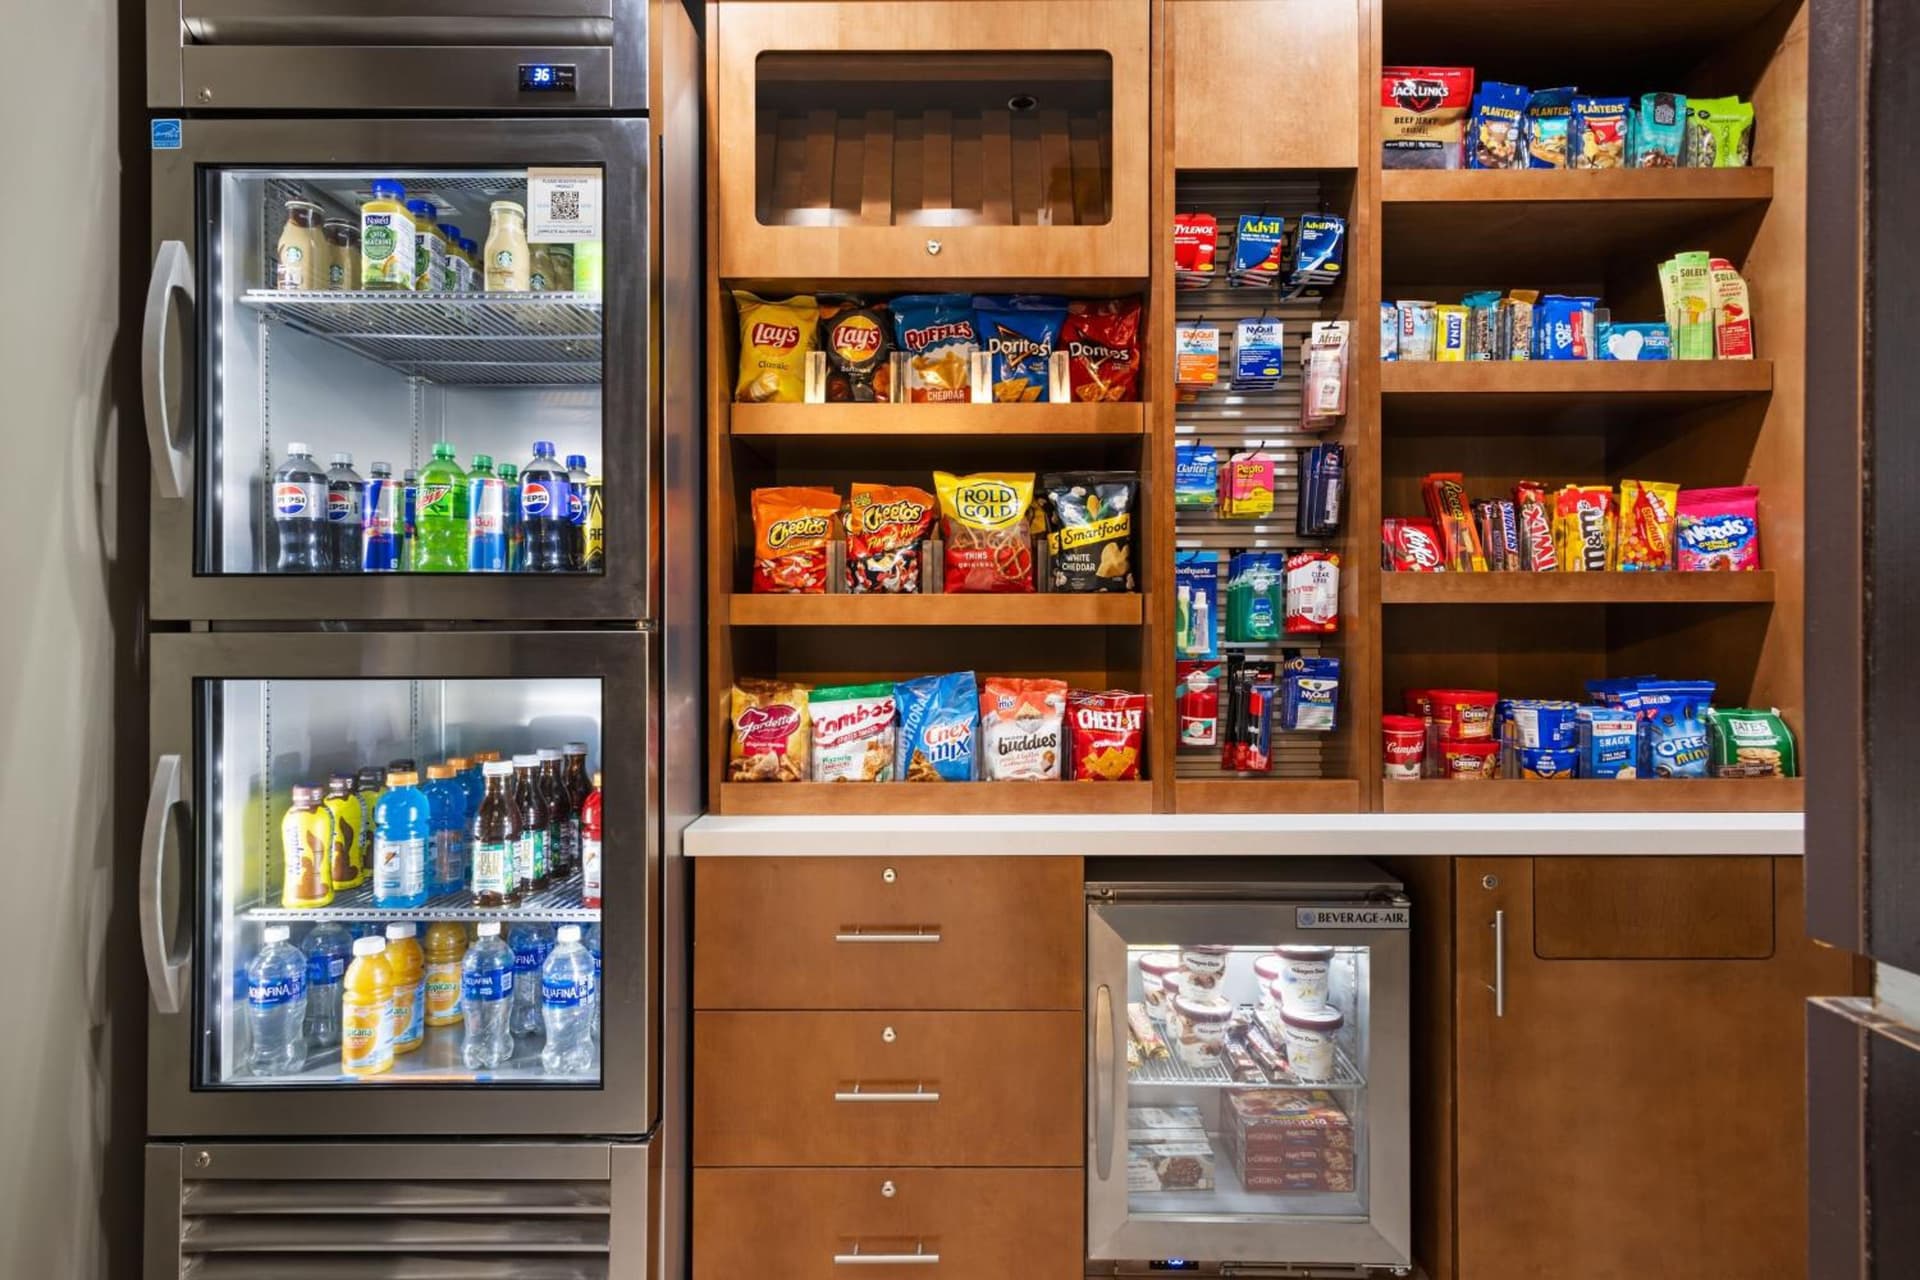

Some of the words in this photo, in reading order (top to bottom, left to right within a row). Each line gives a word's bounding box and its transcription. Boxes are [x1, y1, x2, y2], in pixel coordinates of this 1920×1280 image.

[533, 68, 550, 82] 36
[1390, 84, 1417, 98] JACK
[1578, 103, 1624, 113] PLANTERS
[1174, 224, 1214, 235] TYLENOL
[1243, 221, 1280, 234] Advil
[1680, 268, 1707, 278] SOLELY
[755, 325, 798, 348] Lay's
[905, 321, 974, 352] RUFFLES
[1246, 325, 1273, 335] NyQuil
[836, 328, 879, 350] Lay's
[989, 338, 1051, 358] Doritos
[1070, 341, 1129, 361] Doritos
[927, 389, 965, 401] CHEDDAR
[278, 496, 306, 505] PPSI
[964, 489, 1012, 503] ROLD
[328, 503, 350, 511] EPSI
[964, 505, 1012, 519] GOLD
[864, 500, 923, 533] Cheetos
[768, 515, 829, 549] Cheetos
[1063, 519, 1129, 545] Smartfood
[1503, 501, 1517, 551] SNICKERS
[1522, 504, 1559, 572] TWIX
[1067, 553, 1091, 562] WHITE
[1061, 562, 1097, 572] CHEDDAR
[815, 698, 895, 738] Combos
[925, 716, 971, 746] Chex
[998, 733, 1057, 756] buddies
[1600, 736, 1631, 747] SNACK
